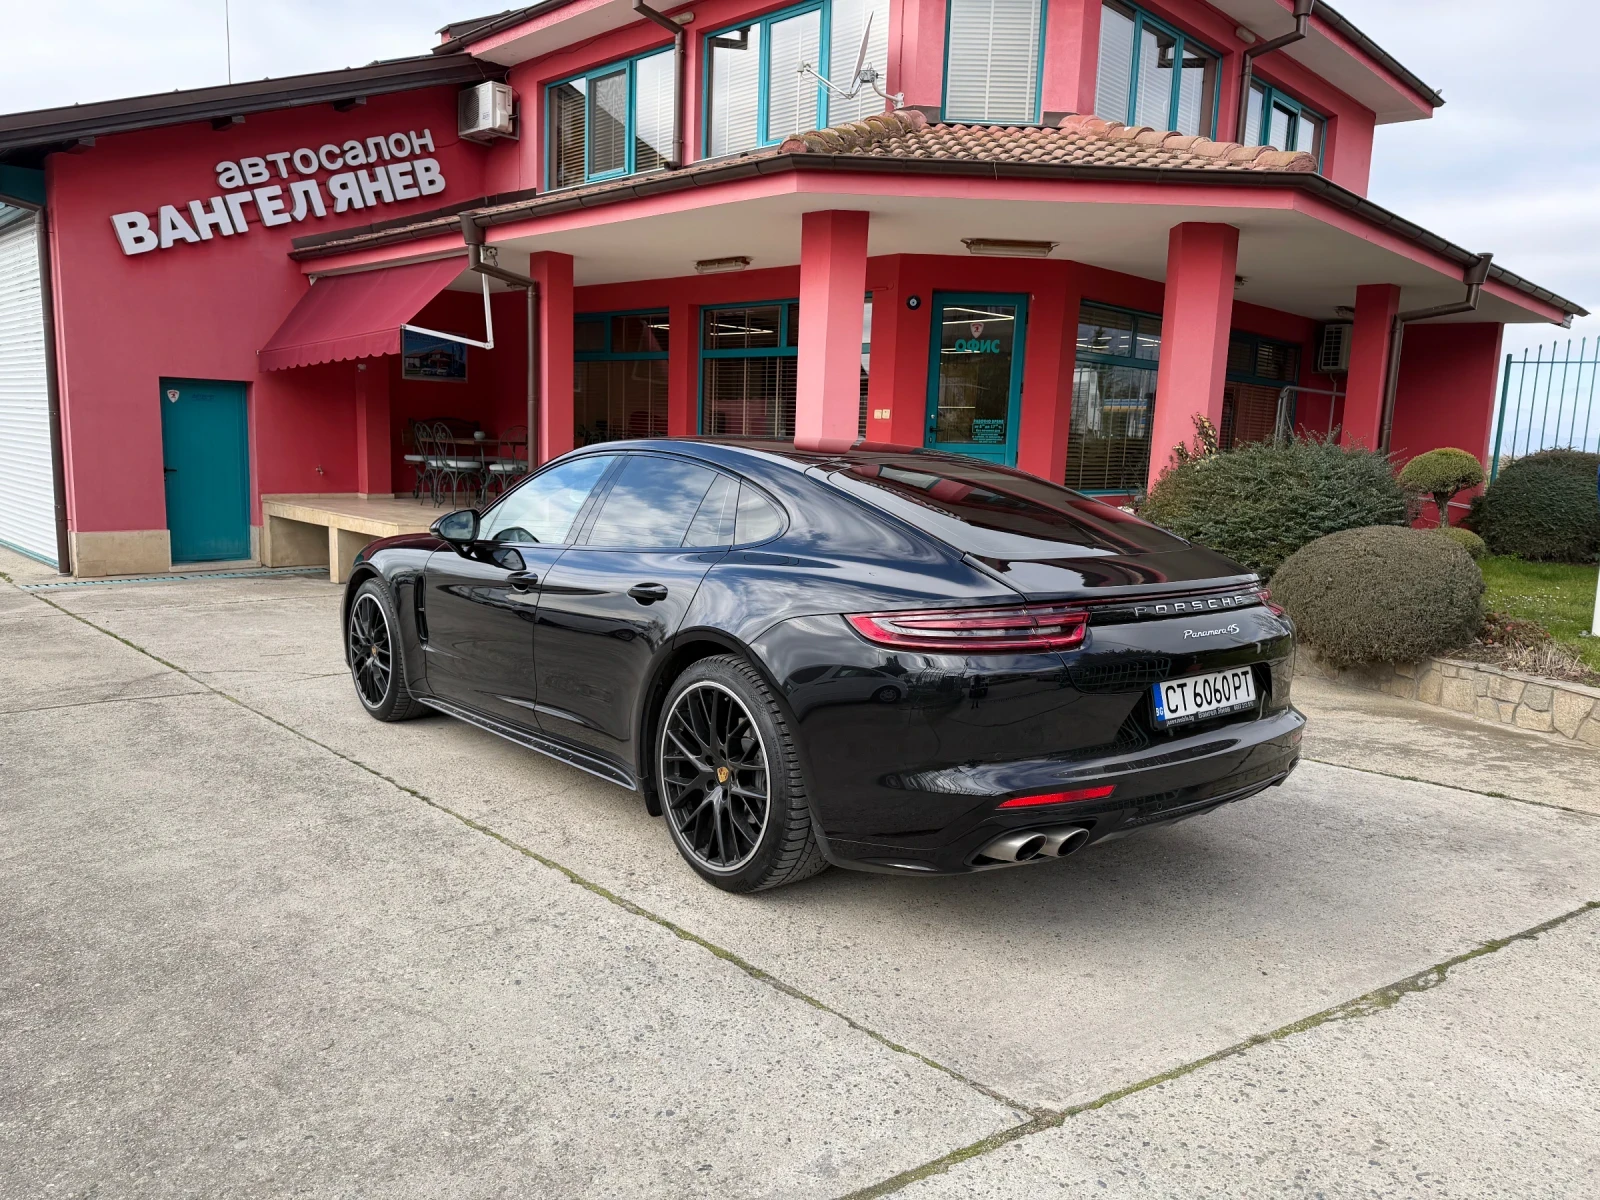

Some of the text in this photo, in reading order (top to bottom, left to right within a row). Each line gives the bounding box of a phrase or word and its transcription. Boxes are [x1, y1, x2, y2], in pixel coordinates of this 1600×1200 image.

[215, 128, 435, 189] автосалон
[110, 158, 446, 256] ВАНГЕЛ ЯНЕВ
[955, 338, 1000, 354] ОФИС
[1134, 595, 1243, 617] PORSCHE
[1156, 707, 1164, 717] BG
